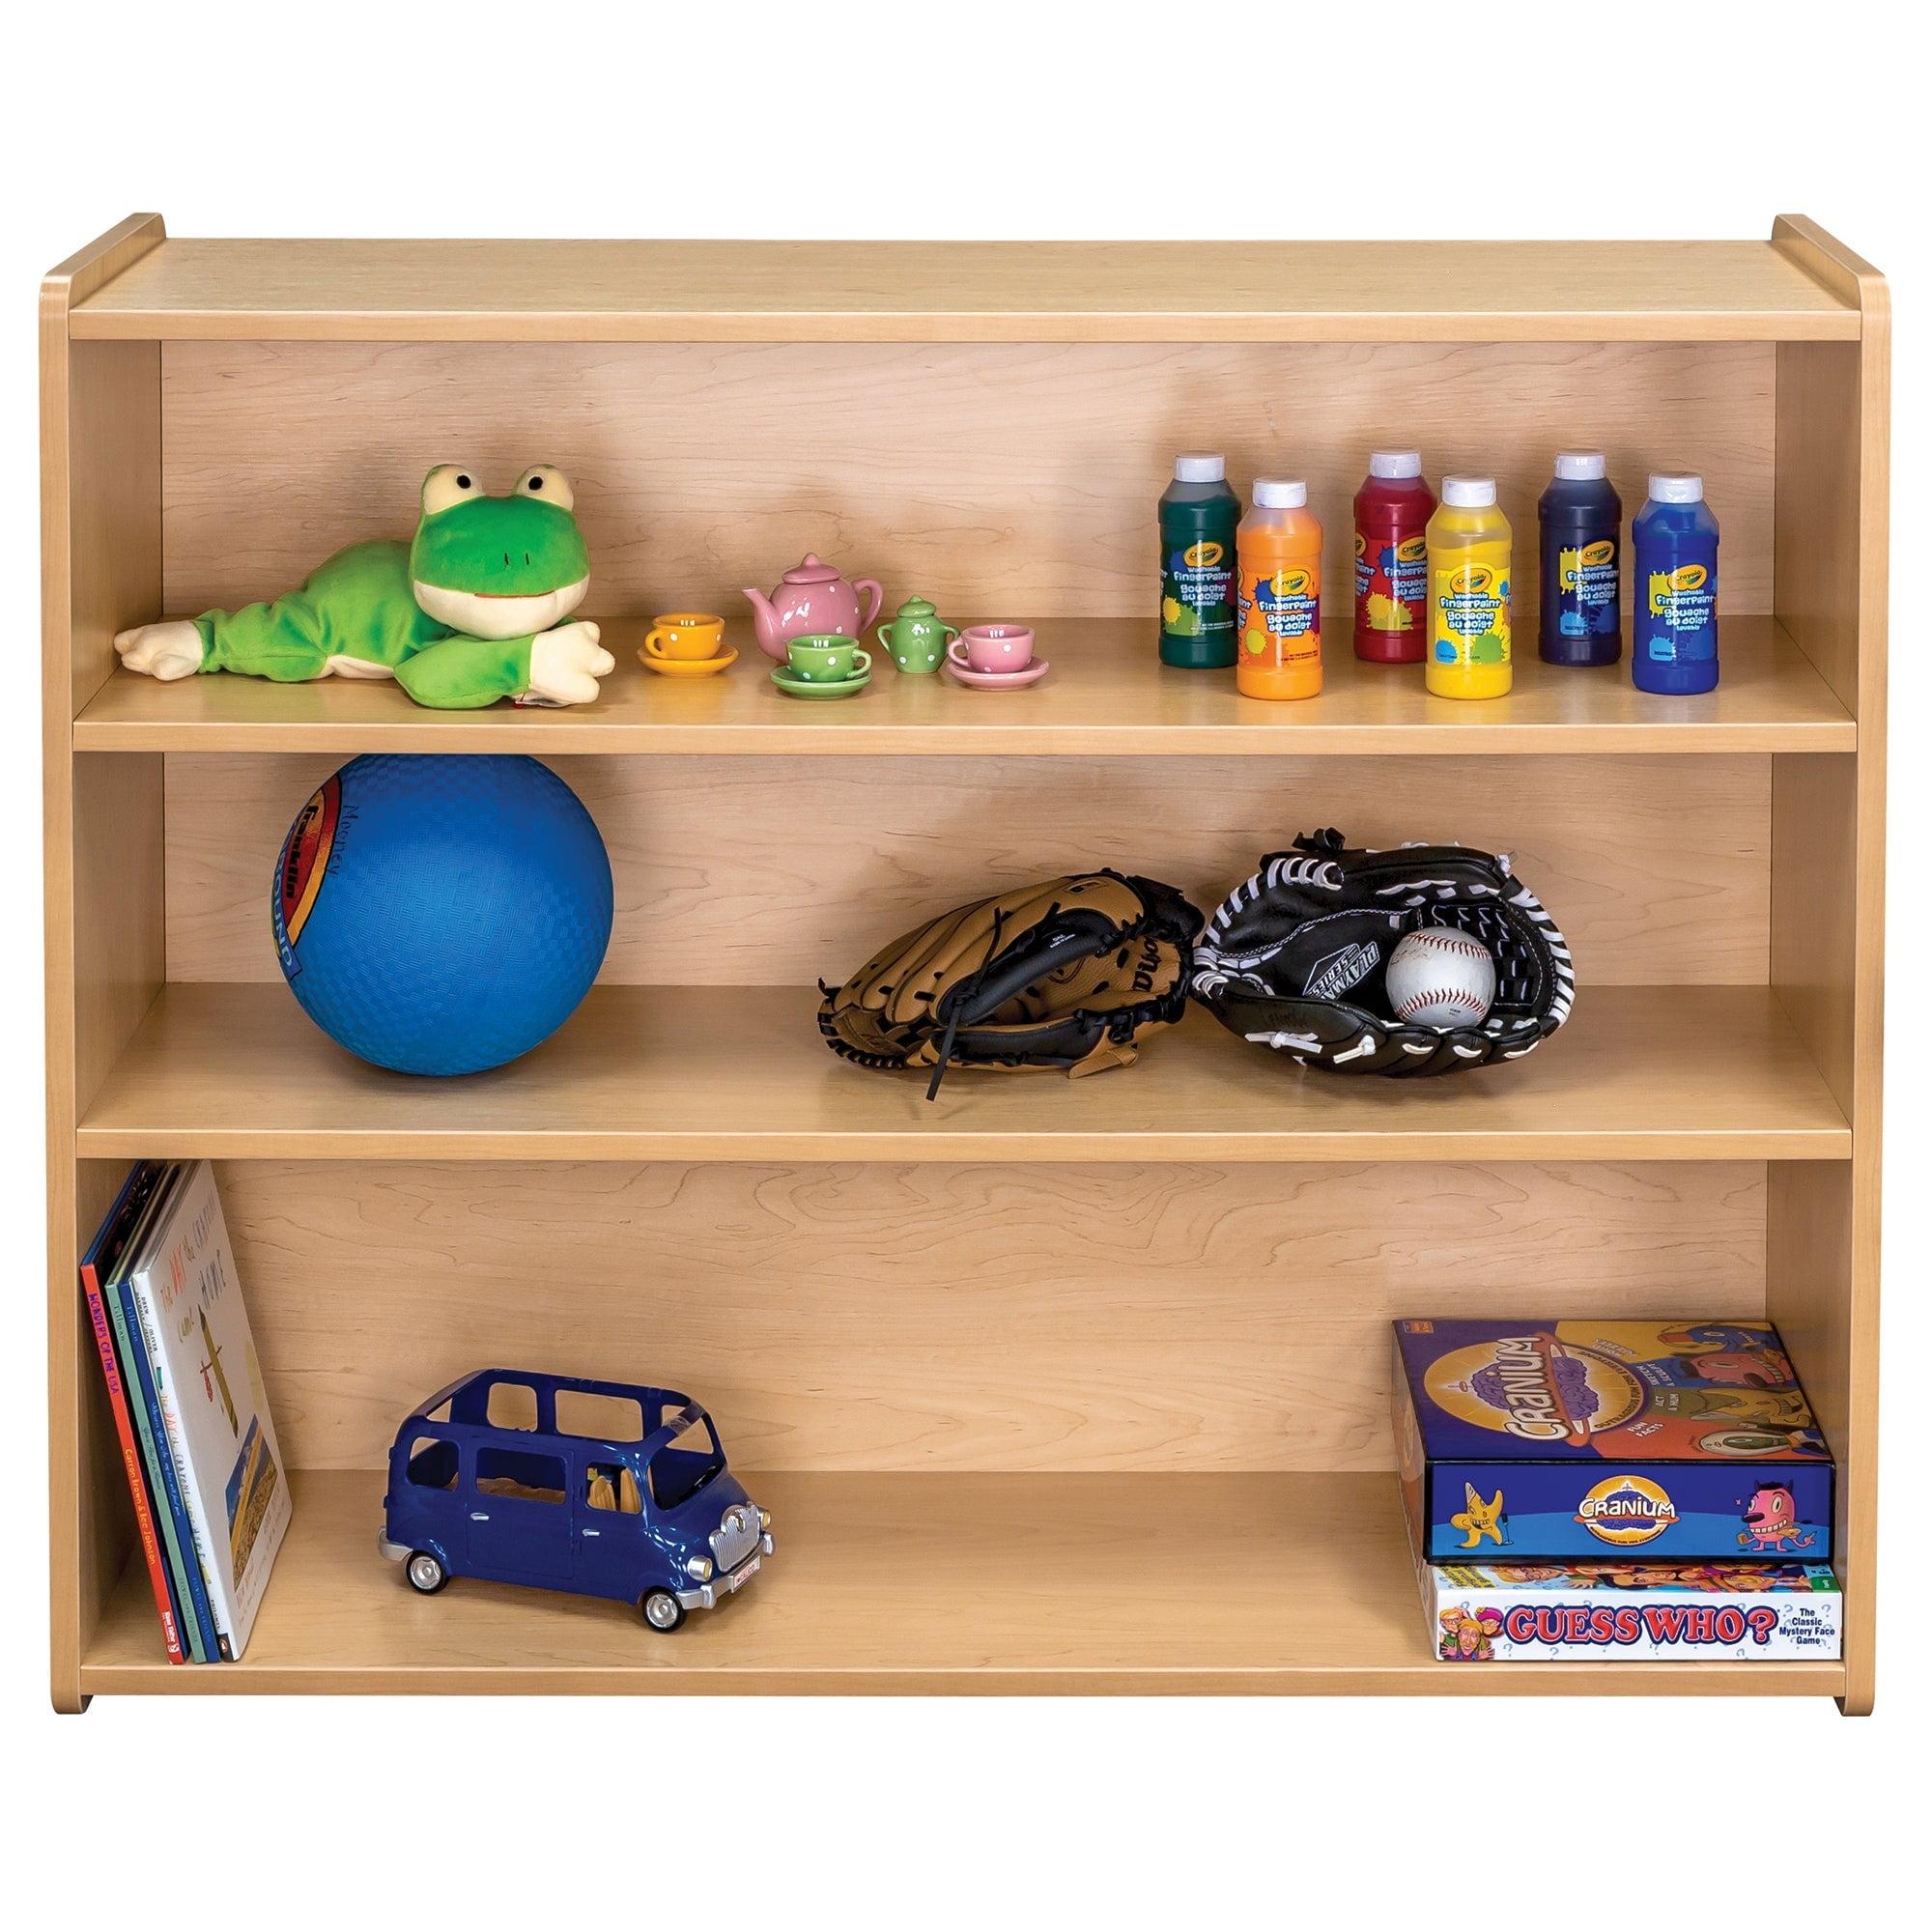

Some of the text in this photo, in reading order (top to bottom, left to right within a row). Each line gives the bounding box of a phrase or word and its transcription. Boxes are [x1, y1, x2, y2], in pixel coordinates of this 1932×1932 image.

[328, 805, 359, 876] Mooney
[1312, 955, 1349, 997] SERIES
[1321, 944, 1378, 1000] PLAYMA
[88, 1293, 119, 1394] WONDERS OF THE USA
[1505, 1607, 1640, 1643] GUESS
[1779, 1627, 1835, 1636] Mystery Face
[1792, 1617, 1822, 1626] Classic
[1797, 1635, 1821, 1644] Game
